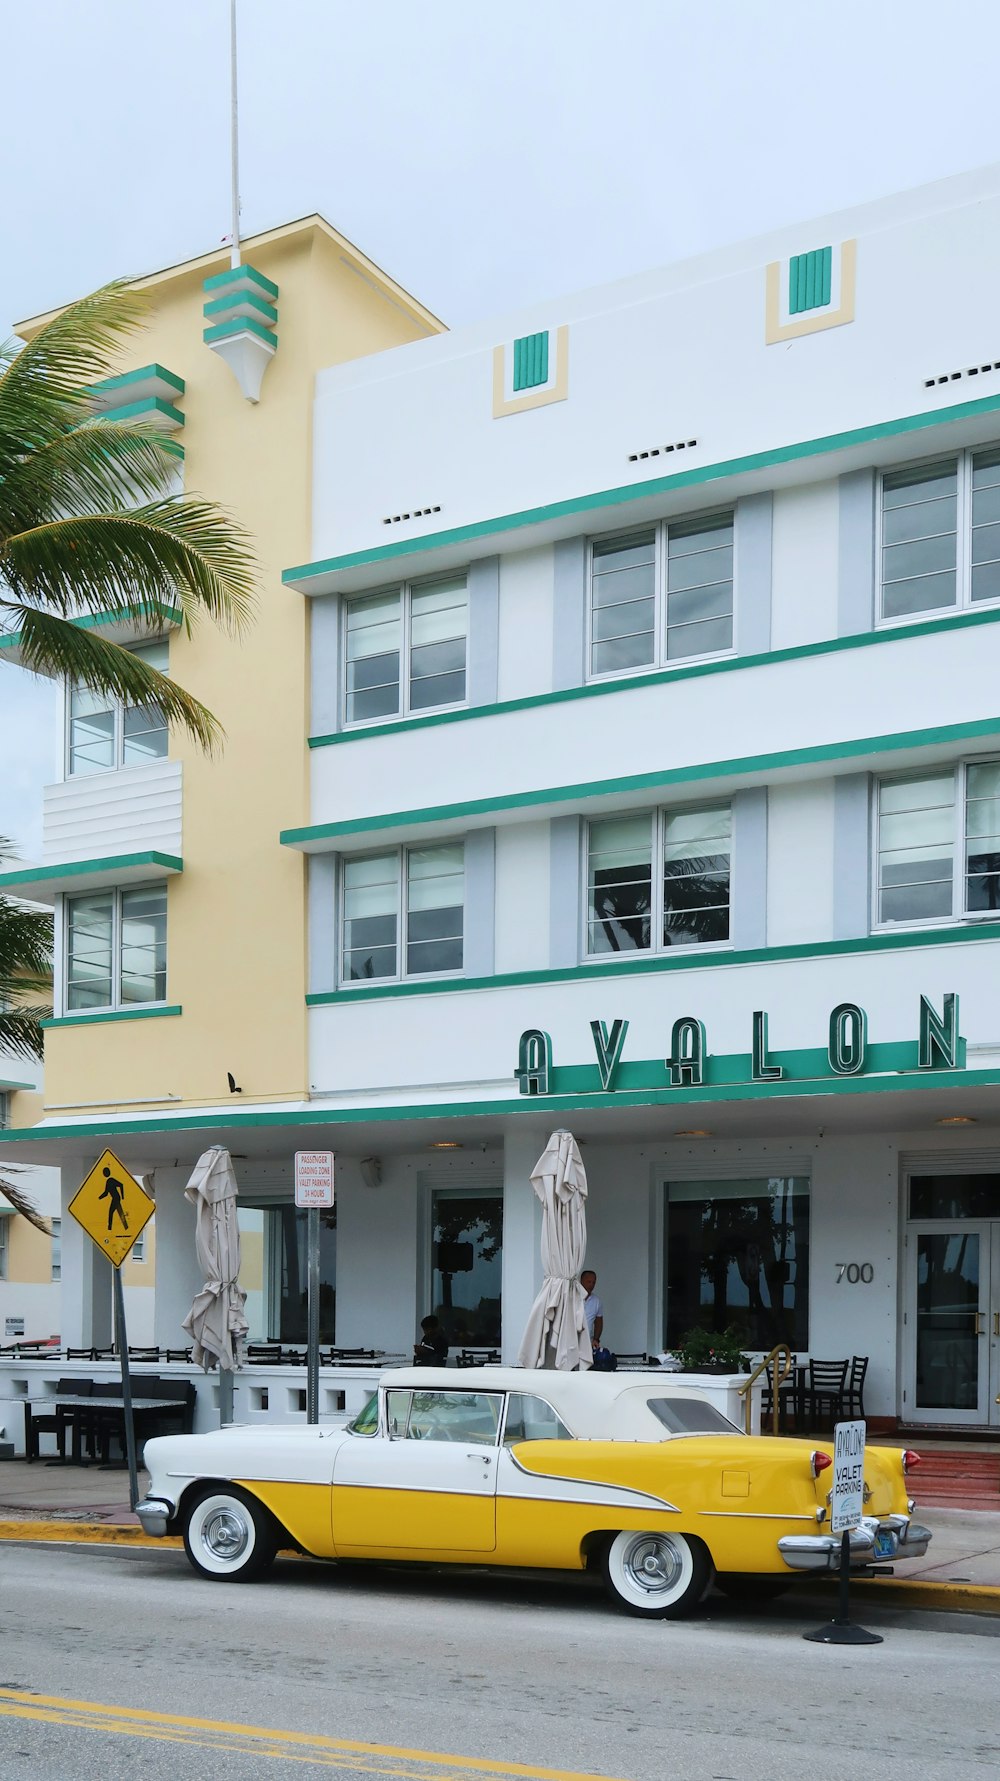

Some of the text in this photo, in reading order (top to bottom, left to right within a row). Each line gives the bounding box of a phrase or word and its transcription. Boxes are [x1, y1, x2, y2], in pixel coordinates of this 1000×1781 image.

[514, 992, 959, 1095] AVALON
[301, 1155, 328, 1164] PASSENGER
[299, 1166, 330, 1175] LOADING ZONE
[299, 1178, 330, 1187] VALET PARKING
[310, 1189, 325, 1198] HOURS
[835, 1263, 874, 1284] 700
[837, 1428, 862, 1458] AVALON
[836, 1465, 862, 1482] VALET
[835, 1480, 862, 1496] PARKING
